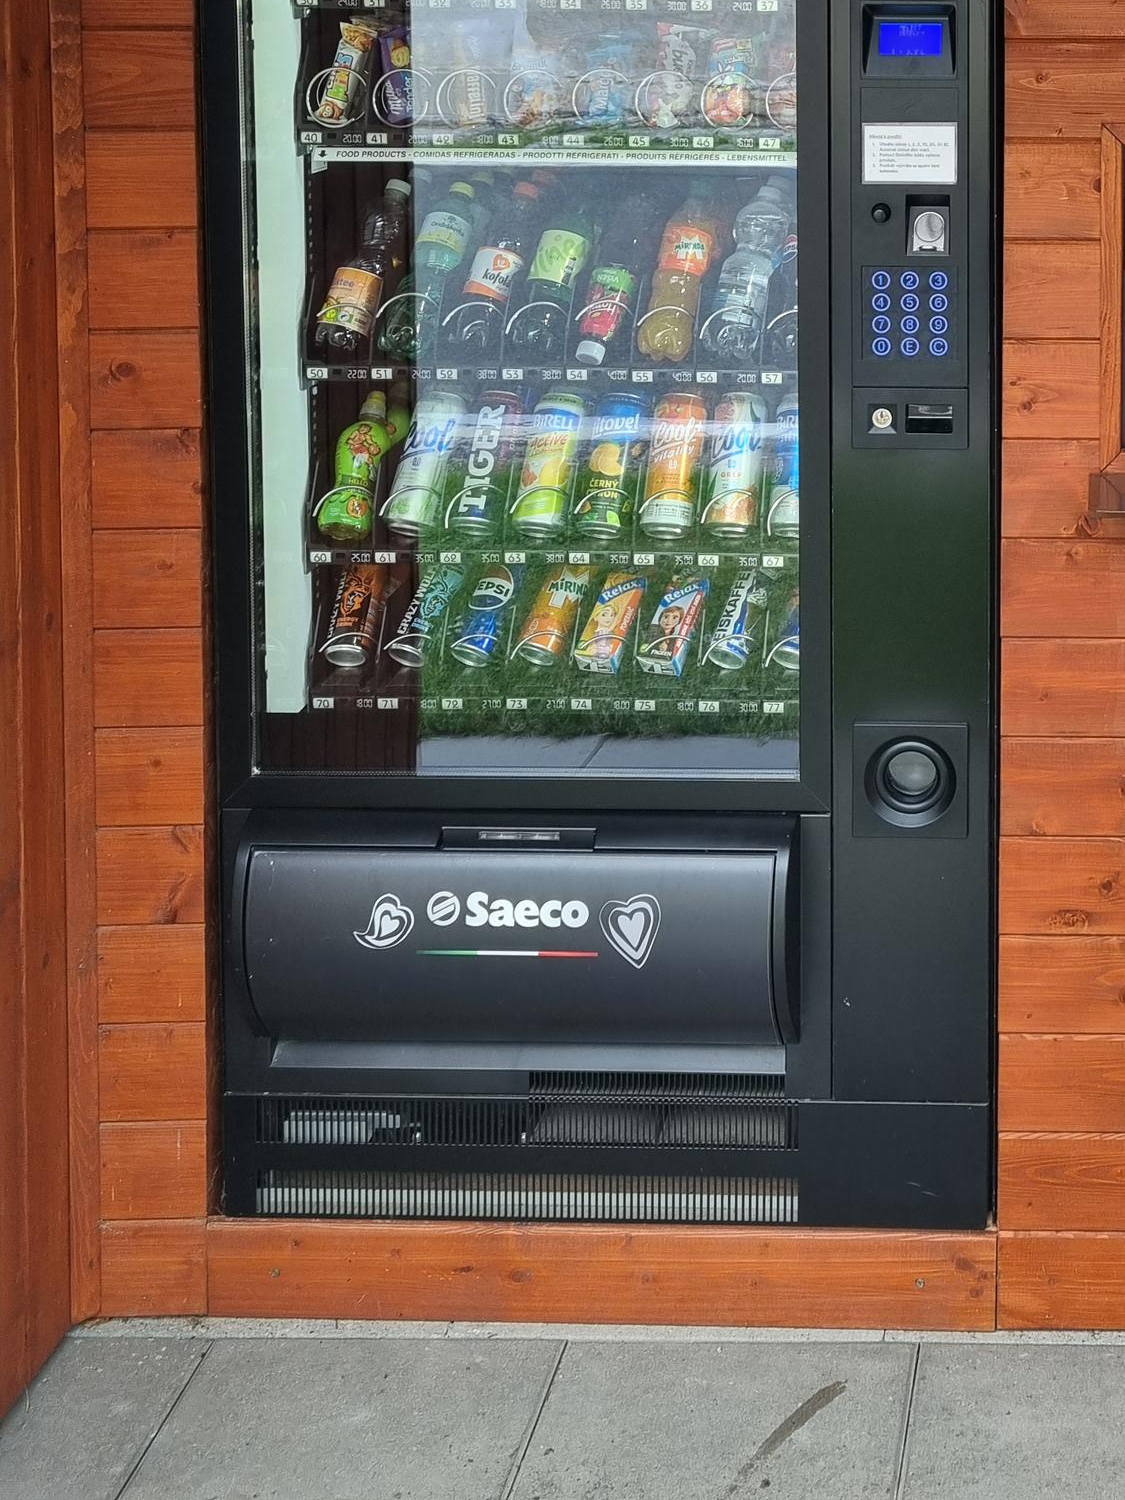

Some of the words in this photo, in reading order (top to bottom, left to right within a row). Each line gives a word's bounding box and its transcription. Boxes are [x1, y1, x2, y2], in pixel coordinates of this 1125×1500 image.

[565, 0, 578, 9] 34
[631, 0, 643, 9] 35
[696, 0, 708, 10] 36
[762, 1, 773, 10] 37
[305, 133, 317, 142] 40
[372, 134, 382, 143] 41
[502, 134, 514, 144] 43
[567, 136, 579, 145] 44
[632, 137, 645, 146] 45
[697, 138, 710, 147] 46
[763, 138, 775, 147] 47
[336, 150, 360, 158] FOOD
[361, 150, 406, 158] PRODUCTS
[413, 150, 451, 159] COMIDAS
[453, 150, 515, 159] REFRIGERADAS
[522, 151, 564, 160] PRODOTTI
[566, 151, 619, 160] REFRIGERATI
[626, 152, 666, 161] PRODUITS
[726, 153, 788, 162] LEBENSMITTEL
[878, 275, 883, 286] 1
[906, 275, 914, 286] 2
[934, 275, 943, 286] 3
[877, 297, 885, 308] 4
[906, 297, 914, 308] 5
[934, 297, 943, 308] 6
[877, 319, 885, 330] 7
[906, 319, 914, 330] 8
[934, 319, 943, 330] 9
[877, 341, 885, 352] 0
[906, 341, 914, 352] E
[934, 341, 943, 352] C
[311, 369, 323, 378] 50
[376, 370, 387, 379] 51
[441, 370, 453, 379] 52
[507, 370, 518, 379] 53
[570, 371, 582, 379] 54
[636, 371, 648, 380] 55
[701, 372, 713, 381] 56
[766, 373, 778, 382] 57
[459, 404, 506, 514] TIGER
[348, 478, 368, 487] HELLO
[589, 478, 619, 489] ČERNÝ
[314, 553, 326, 563] 60
[380, 553, 391, 562] 61
[444, 554, 456, 563] 62
[508, 554, 520, 562] 63
[572, 554, 584, 563] 64
[638, 555, 650, 564] 65
[702, 556, 714, 565] 66
[767, 557, 779, 566] 67
[397, 599, 420, 634] CRAZY
[317, 699, 329, 707] 70
[382, 699, 393, 708] 71
[446, 699, 458, 708] 72
[510, 700, 523, 708] 73
[576, 700, 587, 708] 74
[639, 701, 651, 709] 75
[703, 703, 715, 711] 76
[767, 704, 779, 712] 77
[465, 891, 590, 929] Saeco
